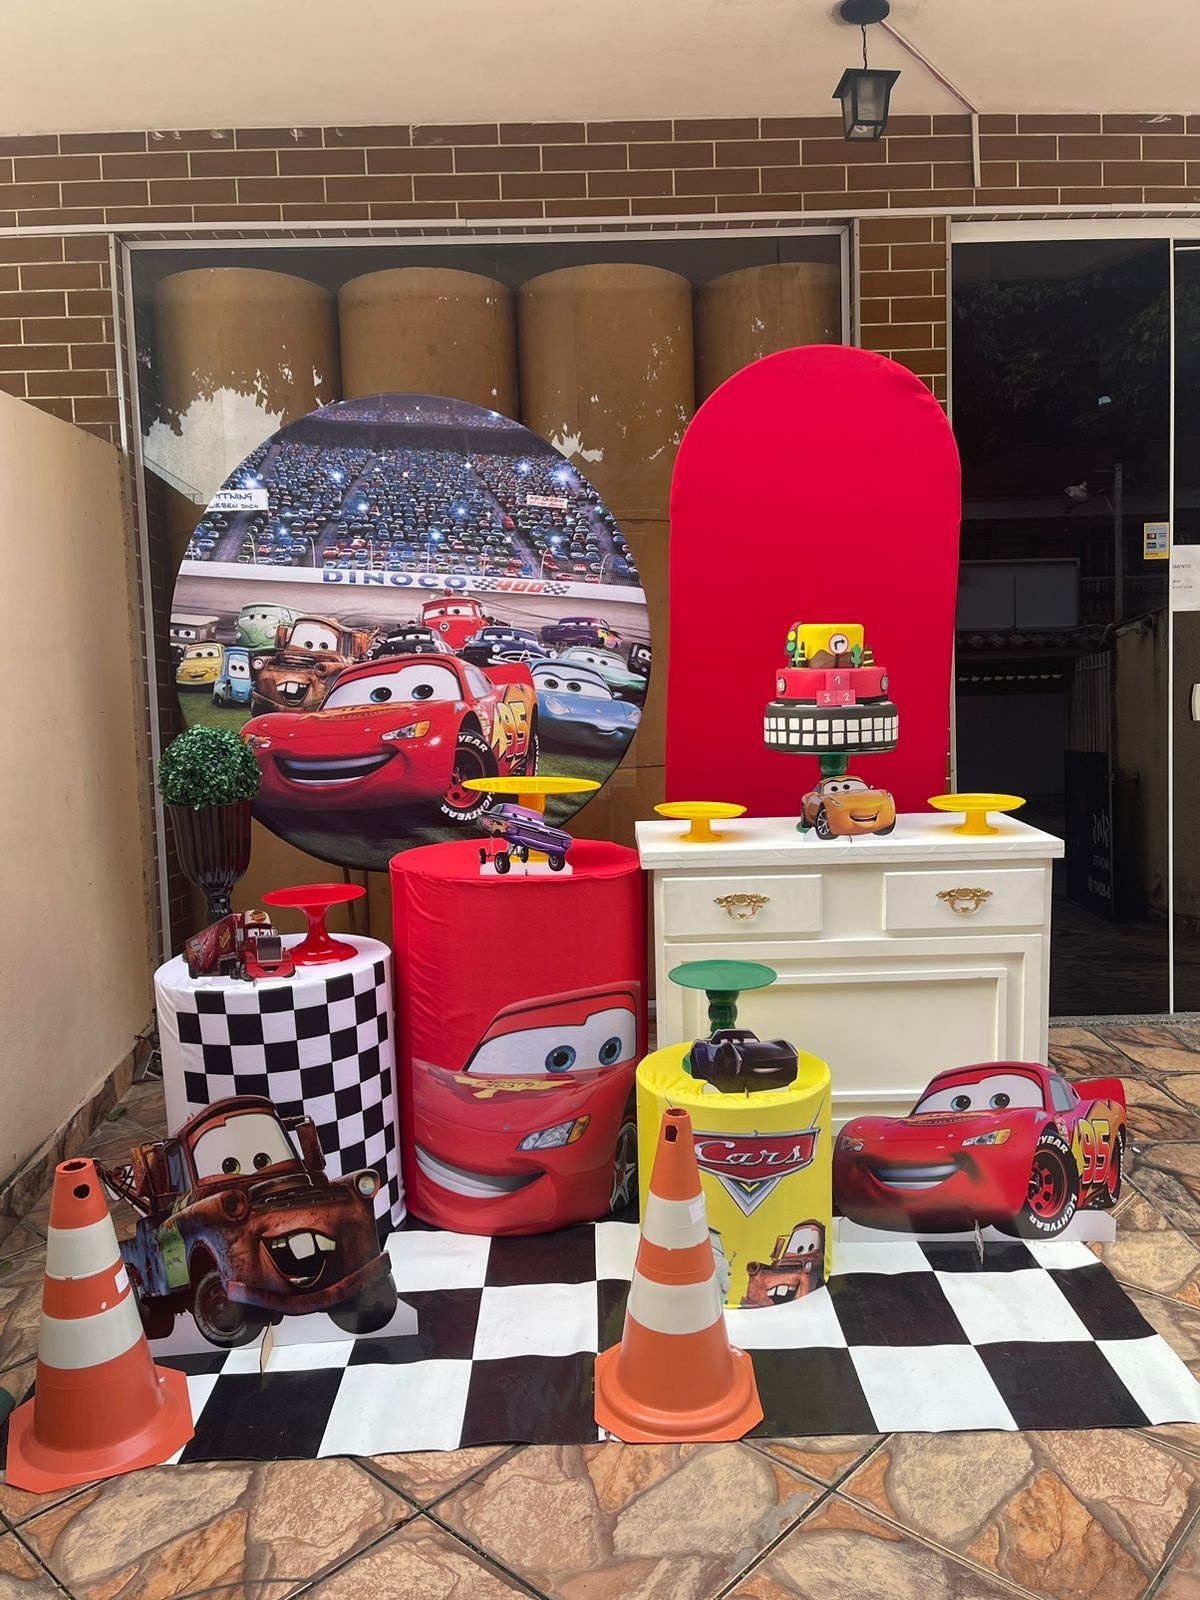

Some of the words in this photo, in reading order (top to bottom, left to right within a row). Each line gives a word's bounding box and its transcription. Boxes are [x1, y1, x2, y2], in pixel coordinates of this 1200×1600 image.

[322, 570, 467, 589] DINOCO
[495, 580, 545, 593] 400
[834, 675, 840, 685] 1
[823, 693, 831, 703] 3
[843, 692, 851, 702] 2
[496, 701, 528, 758] 95
[440, 791, 496, 820] IGHTYEAR
[695, 1140, 804, 1165] Cars
[1078, 1119, 1111, 1184] 95
[1029, 1193, 1078, 1232] LIGHTYEAR
